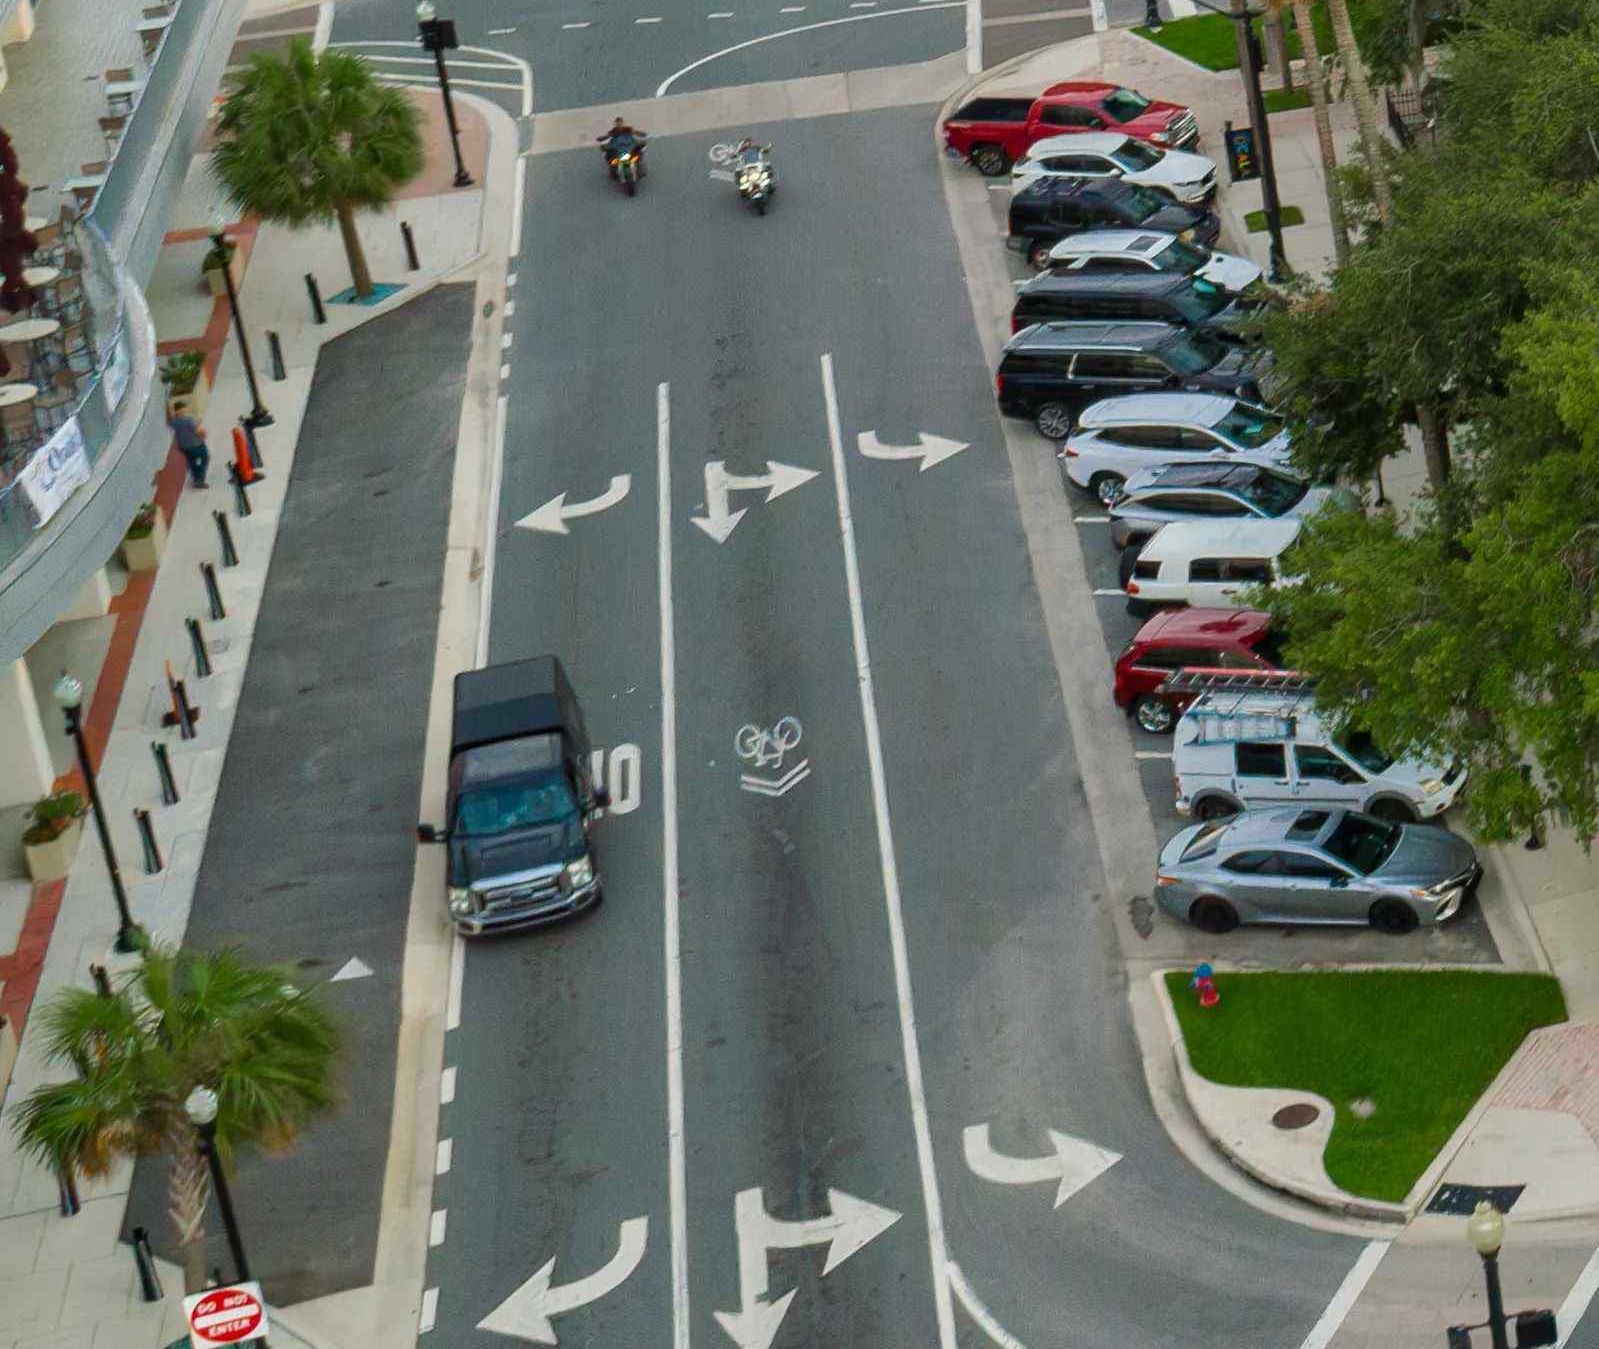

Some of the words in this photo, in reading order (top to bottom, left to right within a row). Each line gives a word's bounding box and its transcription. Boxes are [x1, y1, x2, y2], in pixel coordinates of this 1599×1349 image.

[198, 1301, 217, 1314] DO
[224, 1294, 248, 1308] NOT
[209, 1319, 251, 1337] ENTER
